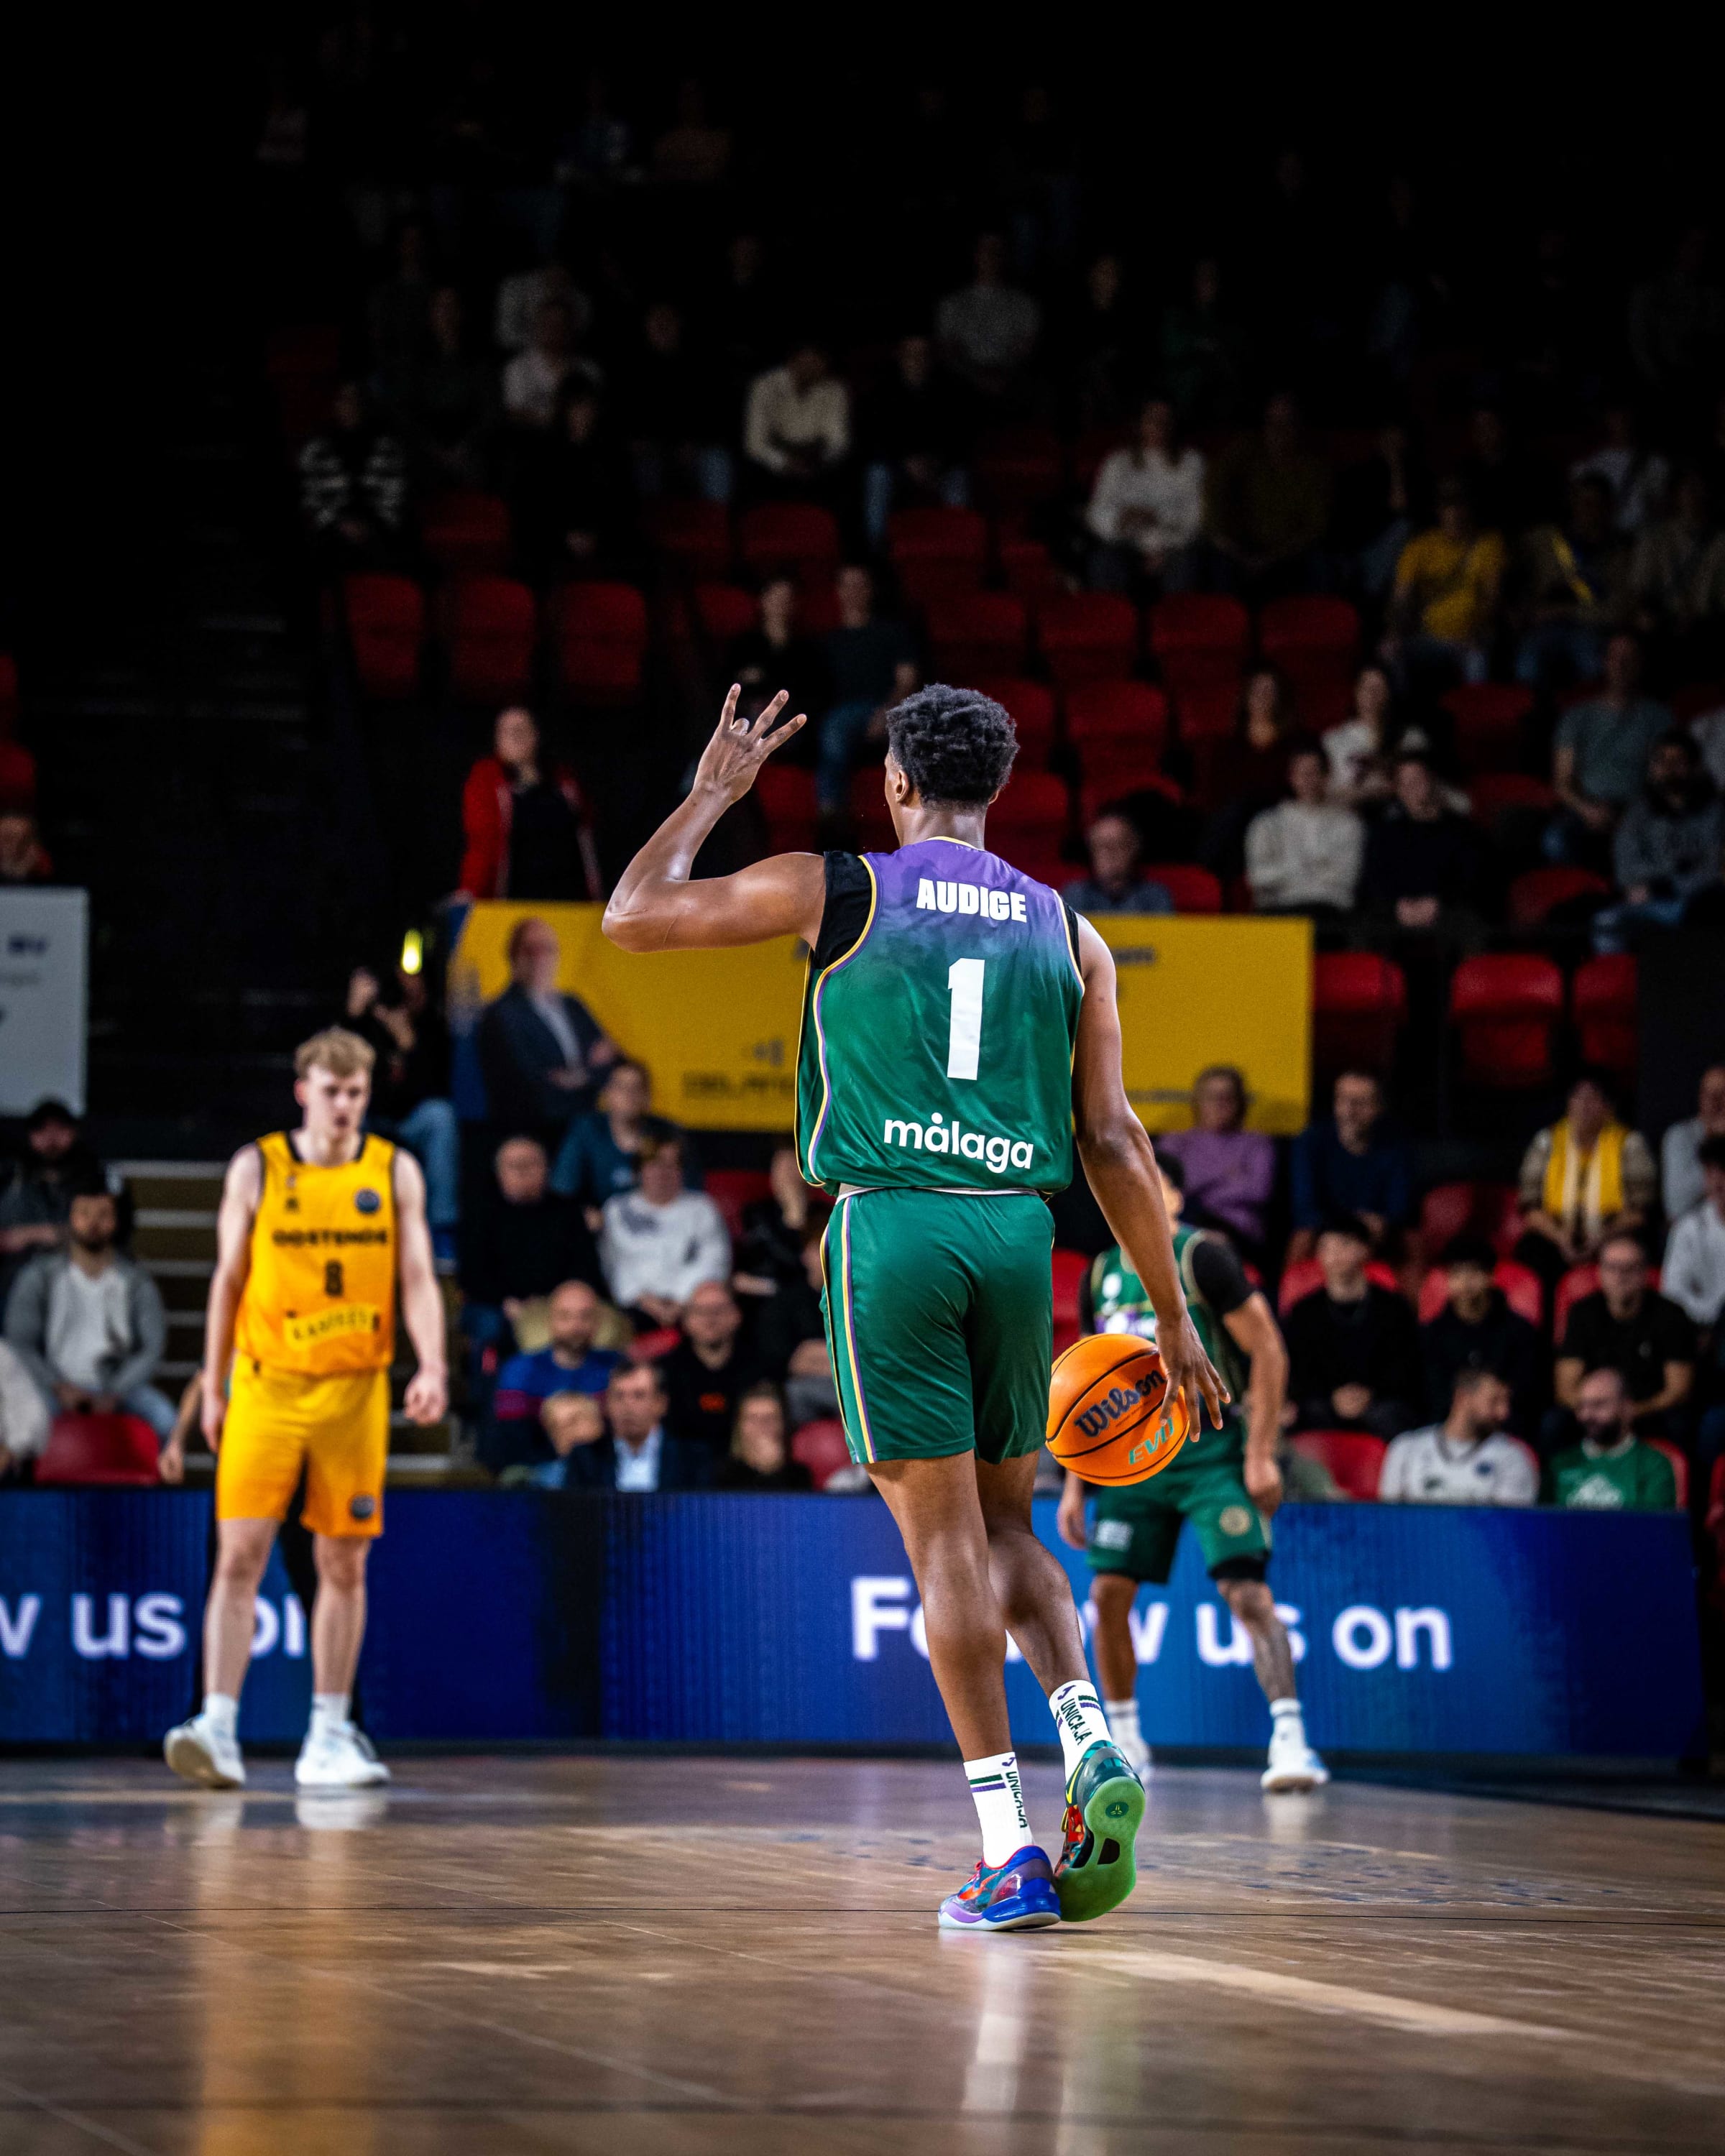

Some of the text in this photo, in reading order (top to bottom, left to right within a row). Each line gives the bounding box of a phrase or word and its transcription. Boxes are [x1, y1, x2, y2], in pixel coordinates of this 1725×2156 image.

[916, 878, 1027, 923] AUDIGE
[947, 958, 985, 1080] 1
[1074, 1370, 1165, 1437] Wilson
[73, 1593, 185, 1659] us
[1332, 1605, 1453, 1672] on
